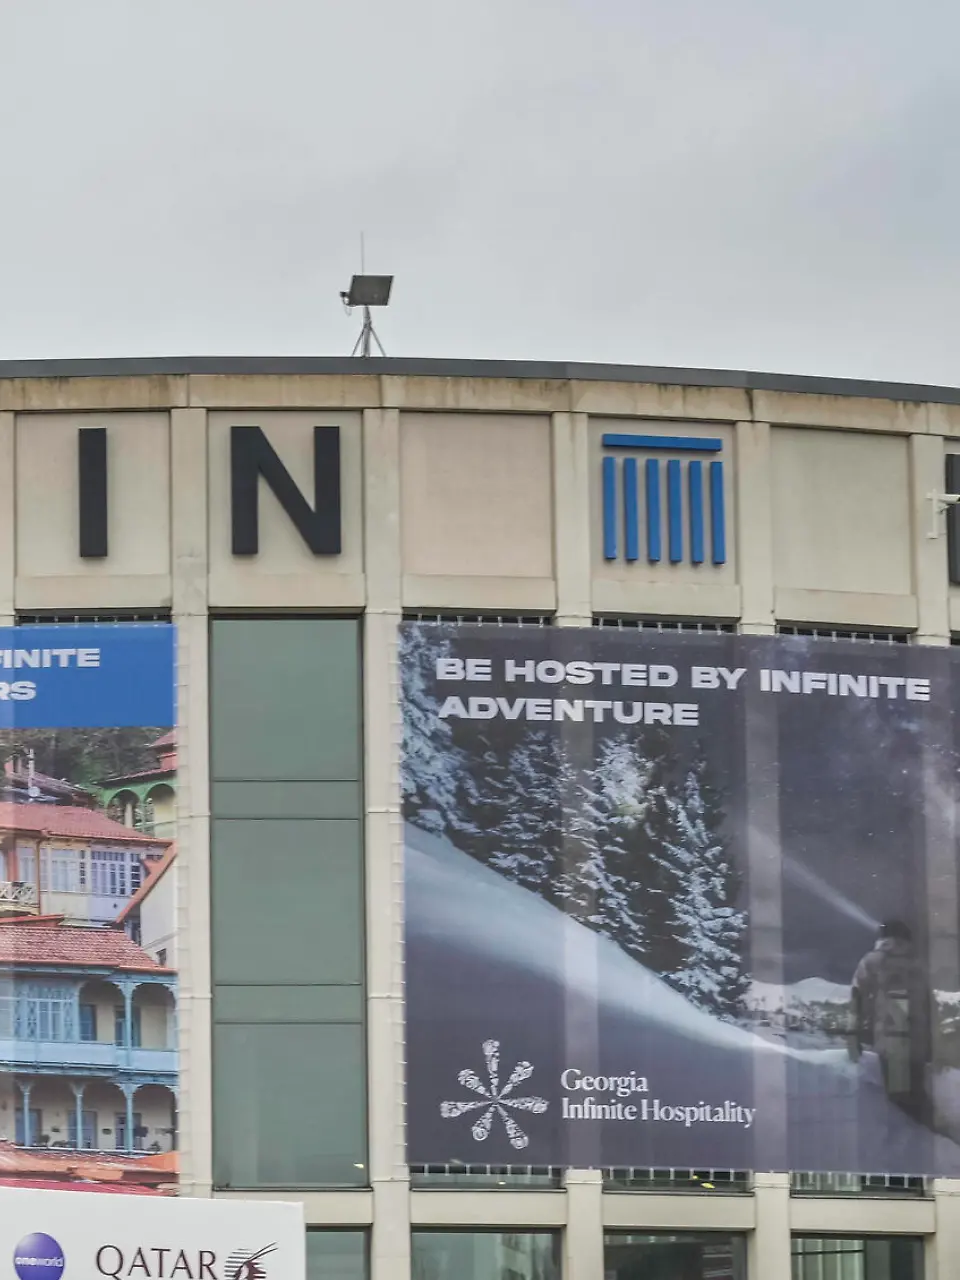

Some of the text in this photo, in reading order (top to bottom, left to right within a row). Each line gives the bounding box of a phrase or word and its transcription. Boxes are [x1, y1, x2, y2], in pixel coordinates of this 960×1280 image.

[436, 658, 931, 702] BE HOSTED BY INFINITE
[438, 696, 700, 727] ADVENTURE
[560, 1069, 649, 1097] Georgia
[562, 1096, 756, 1129] Infinite Hospitality
[15, 1256, 64, 1268] oneworld
